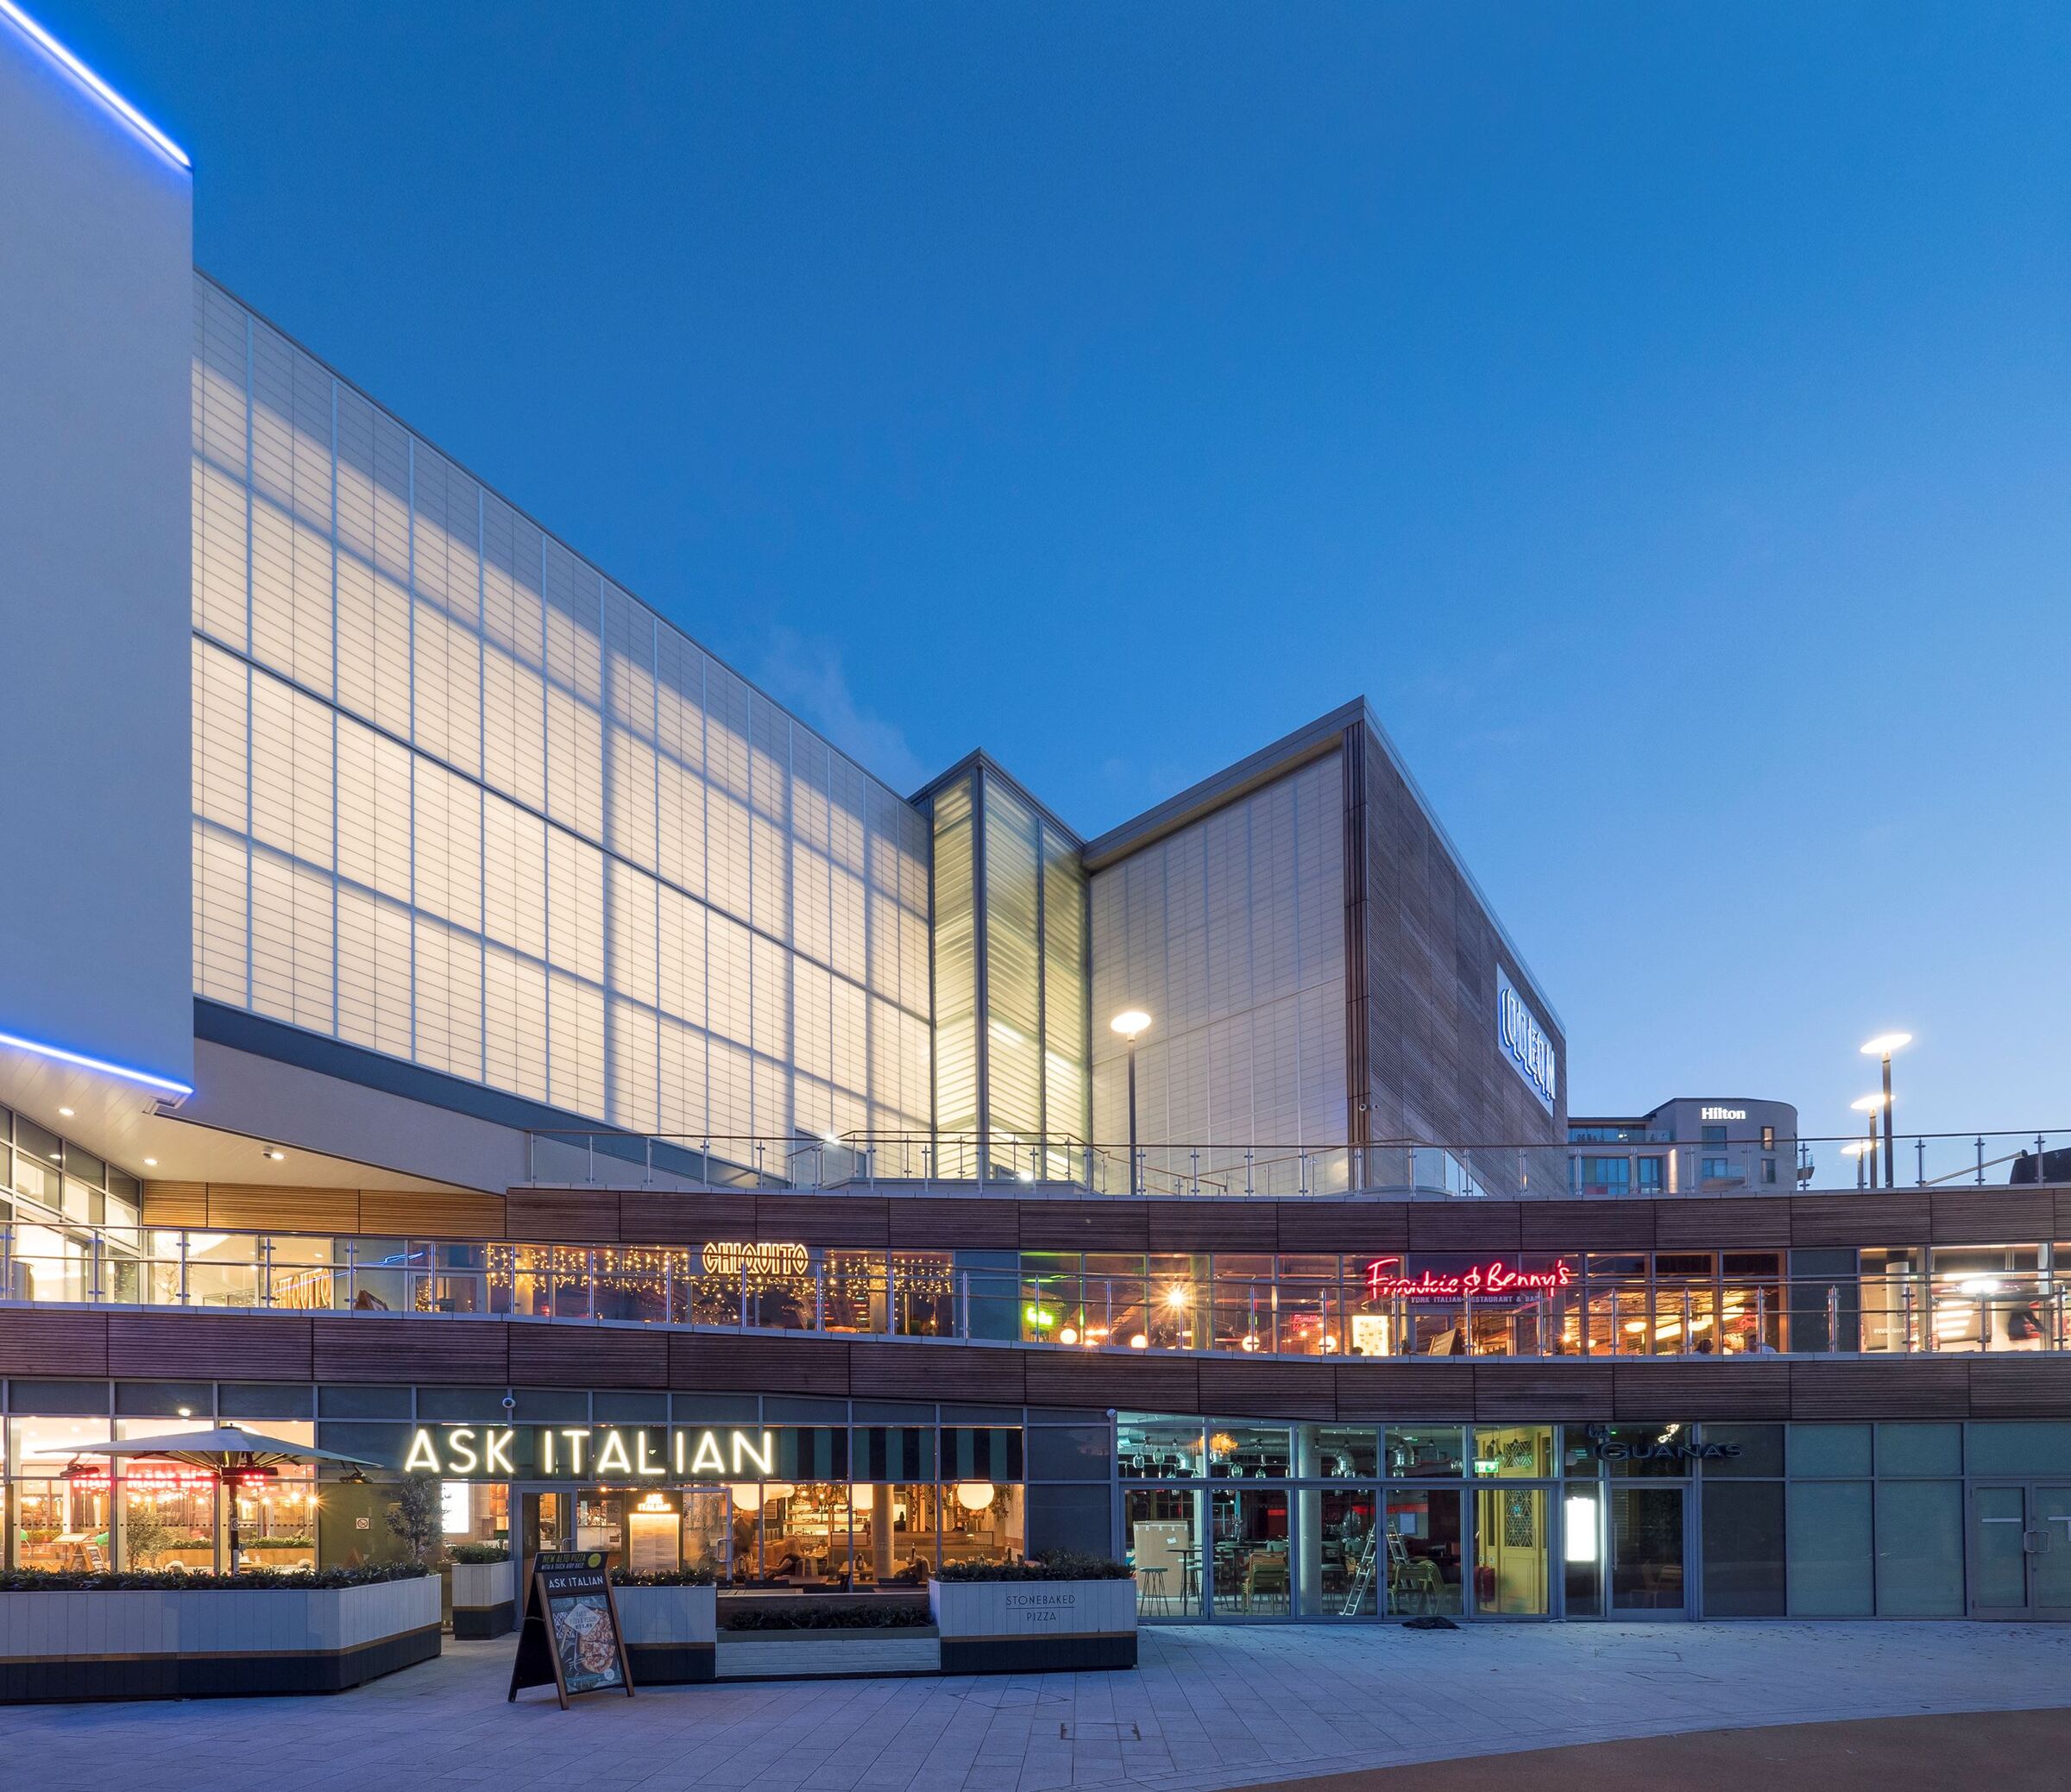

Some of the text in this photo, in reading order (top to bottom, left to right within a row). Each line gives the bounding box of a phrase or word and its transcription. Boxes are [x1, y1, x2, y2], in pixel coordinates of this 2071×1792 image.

[1701, 1107, 1747, 1120] Hilton
[702, 1242, 809, 1275] CHIQUITO
[1367, 1258, 1459, 1299] Frankie
[1486, 1259, 1571, 1298] Benny's
[403, 1428, 773, 1474] ASK ITALIAN
[543, 1555, 557, 1563] NEW
[570, 1553, 586, 1562] PIZZA
[548, 1575, 603, 1588] ASK ITALIAN
[1005, 1594, 1076, 1621] STONEBAKED PIZZA
